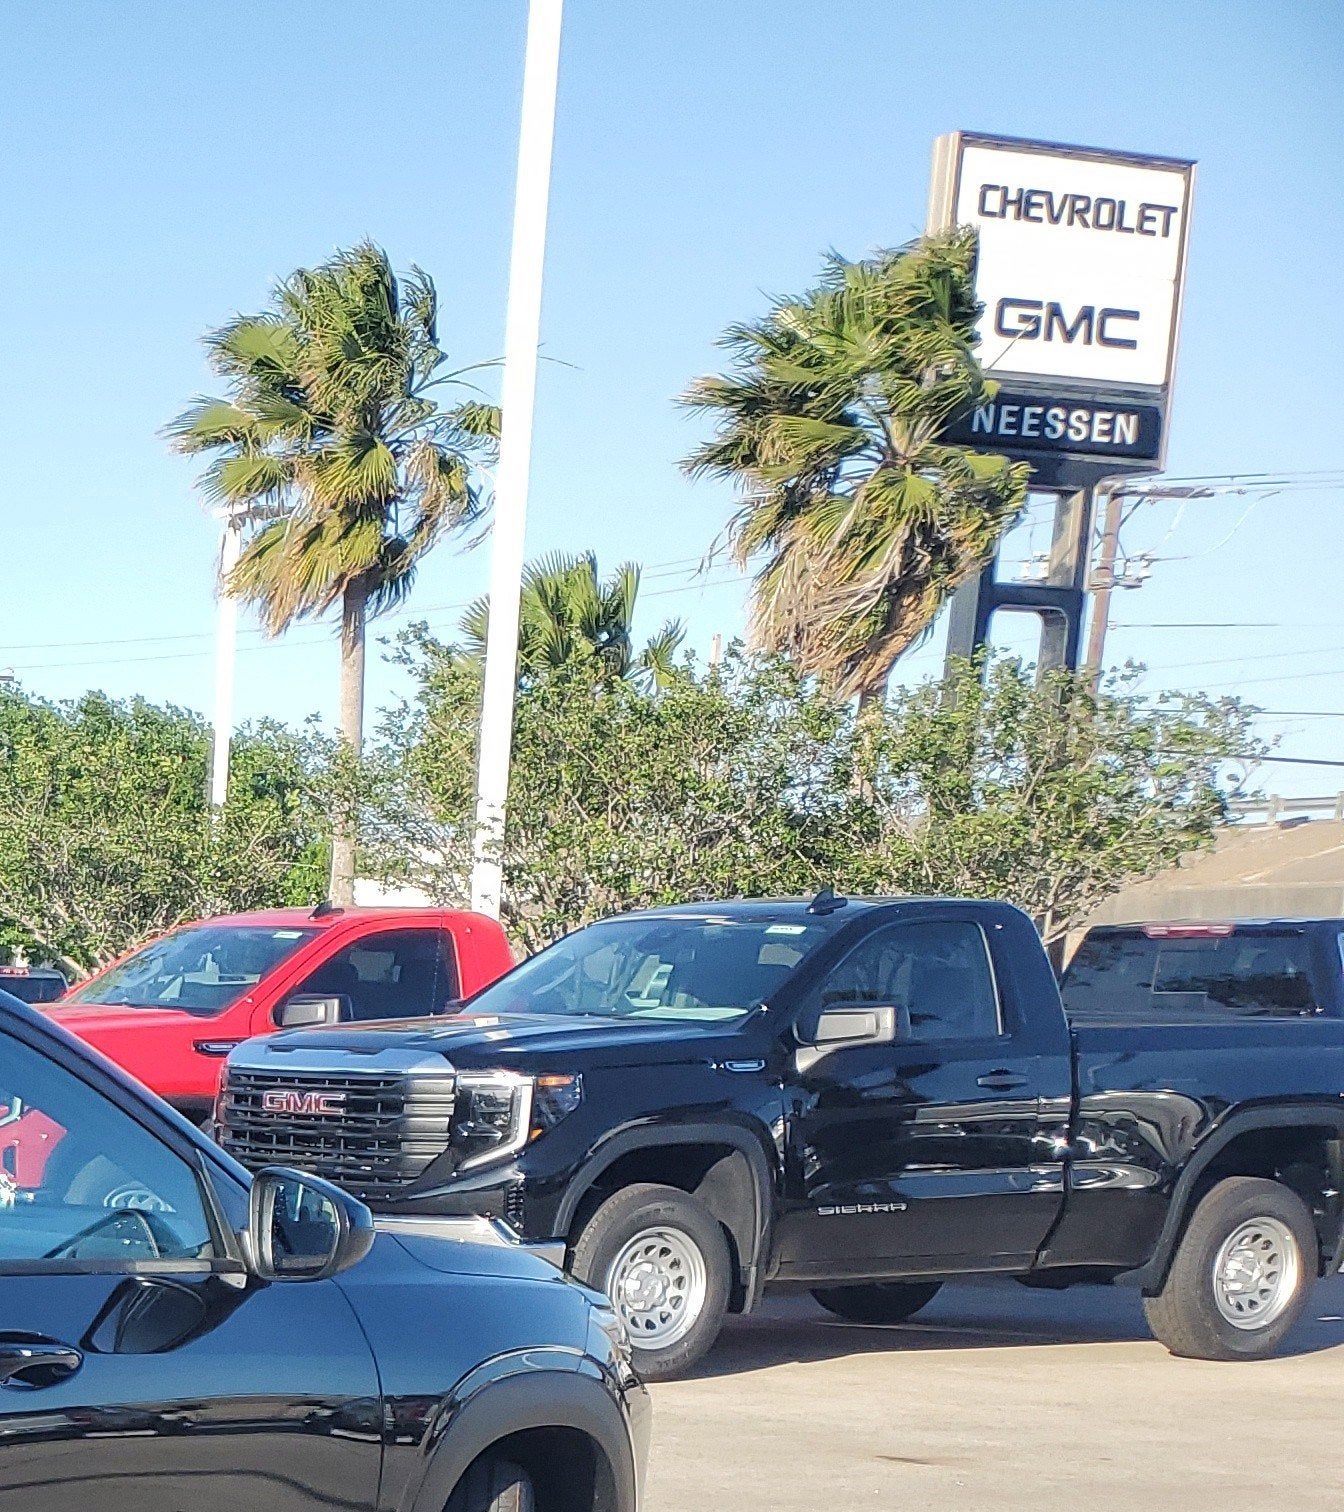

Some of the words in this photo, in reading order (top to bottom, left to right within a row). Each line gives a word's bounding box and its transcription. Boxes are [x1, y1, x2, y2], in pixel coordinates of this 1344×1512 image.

[977, 184, 1178, 238] CHEVROLET
[994, 297, 1141, 350] GMC
[972, 404, 1139, 446] NEESSEN
[262, 1090, 346, 1115] GMC
[817, 1202, 908, 1216] SIERRA
